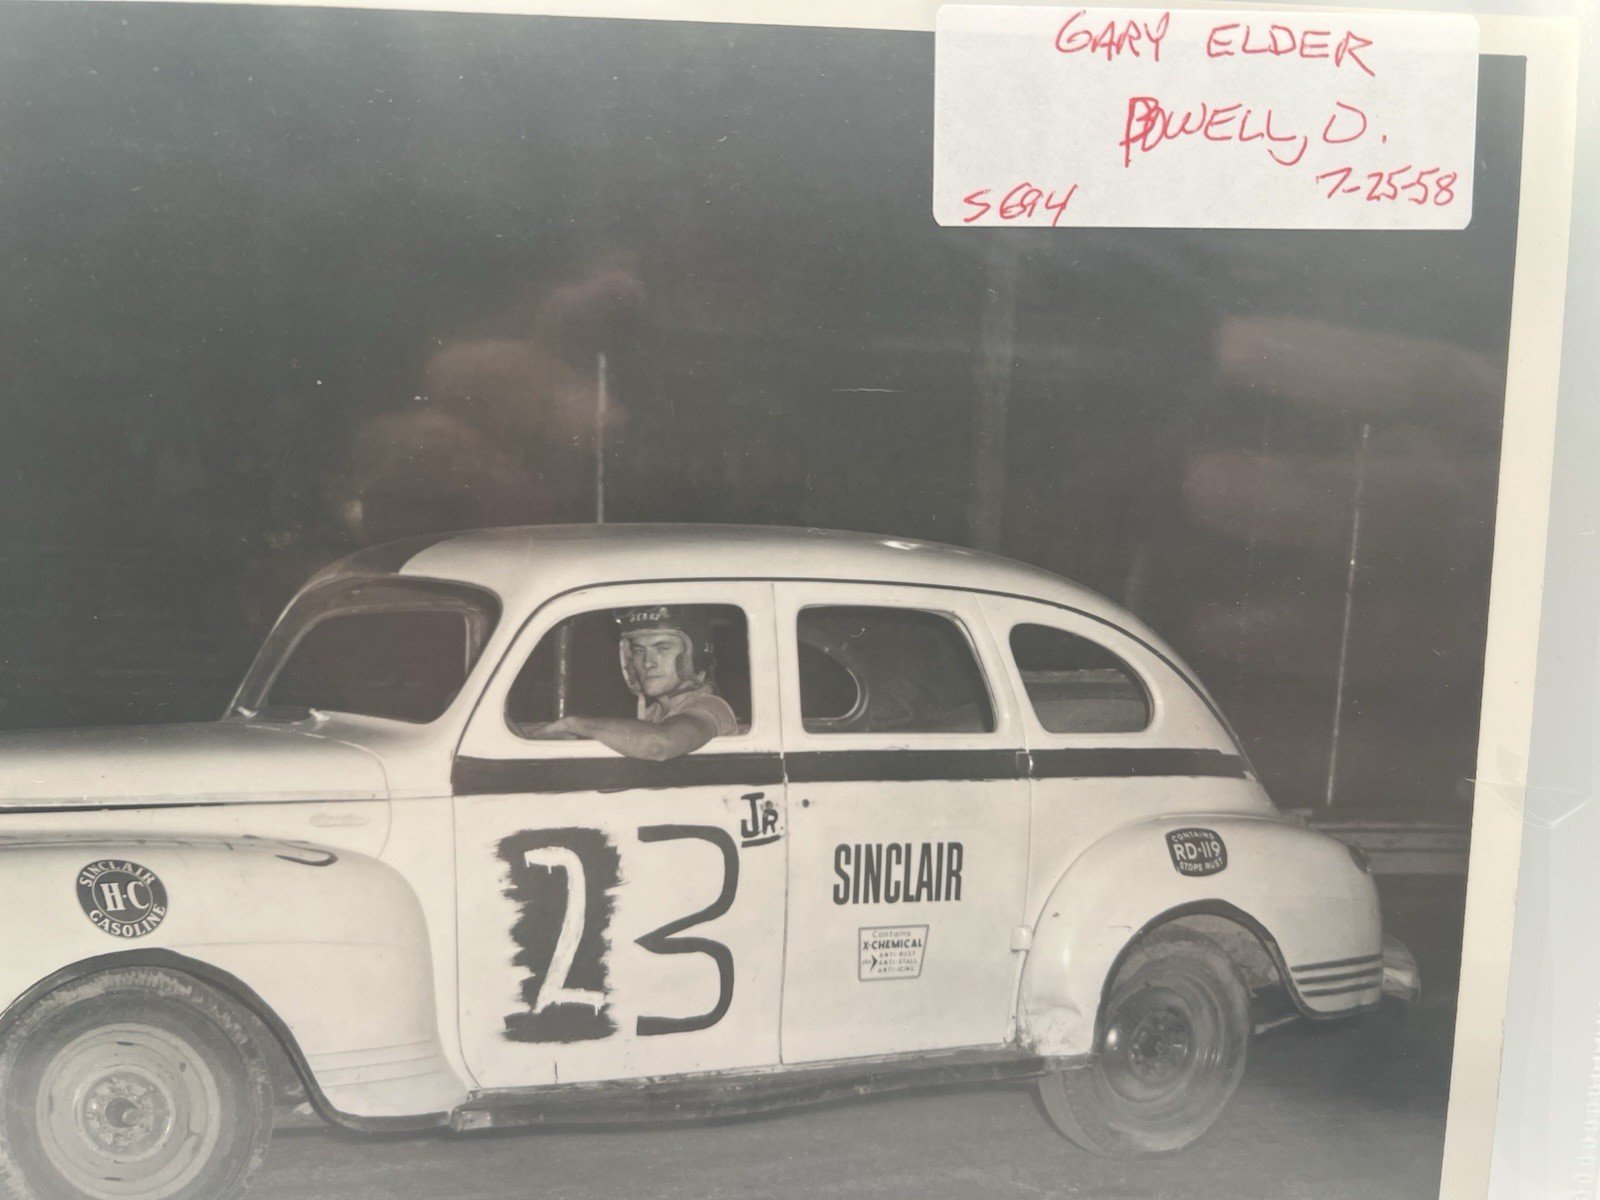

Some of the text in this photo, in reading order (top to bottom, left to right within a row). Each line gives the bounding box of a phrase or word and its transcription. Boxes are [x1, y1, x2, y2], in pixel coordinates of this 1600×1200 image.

[1055, 10, 1376, 76] GARY ELDER
[1316, 165, 1457, 206] 7-25-58
[1171, 830, 1215, 843] CONTAINS
[1173, 840, 1221, 860] RD-119
[79, 860, 156, 887] SINCLAIR
[833, 842, 964, 905] SINCLAIR
[1179, 857, 1223, 872] STOPS RUST
[89, 903, 166, 937] GASOLINE
[522, 824, 740, 1036] 23
